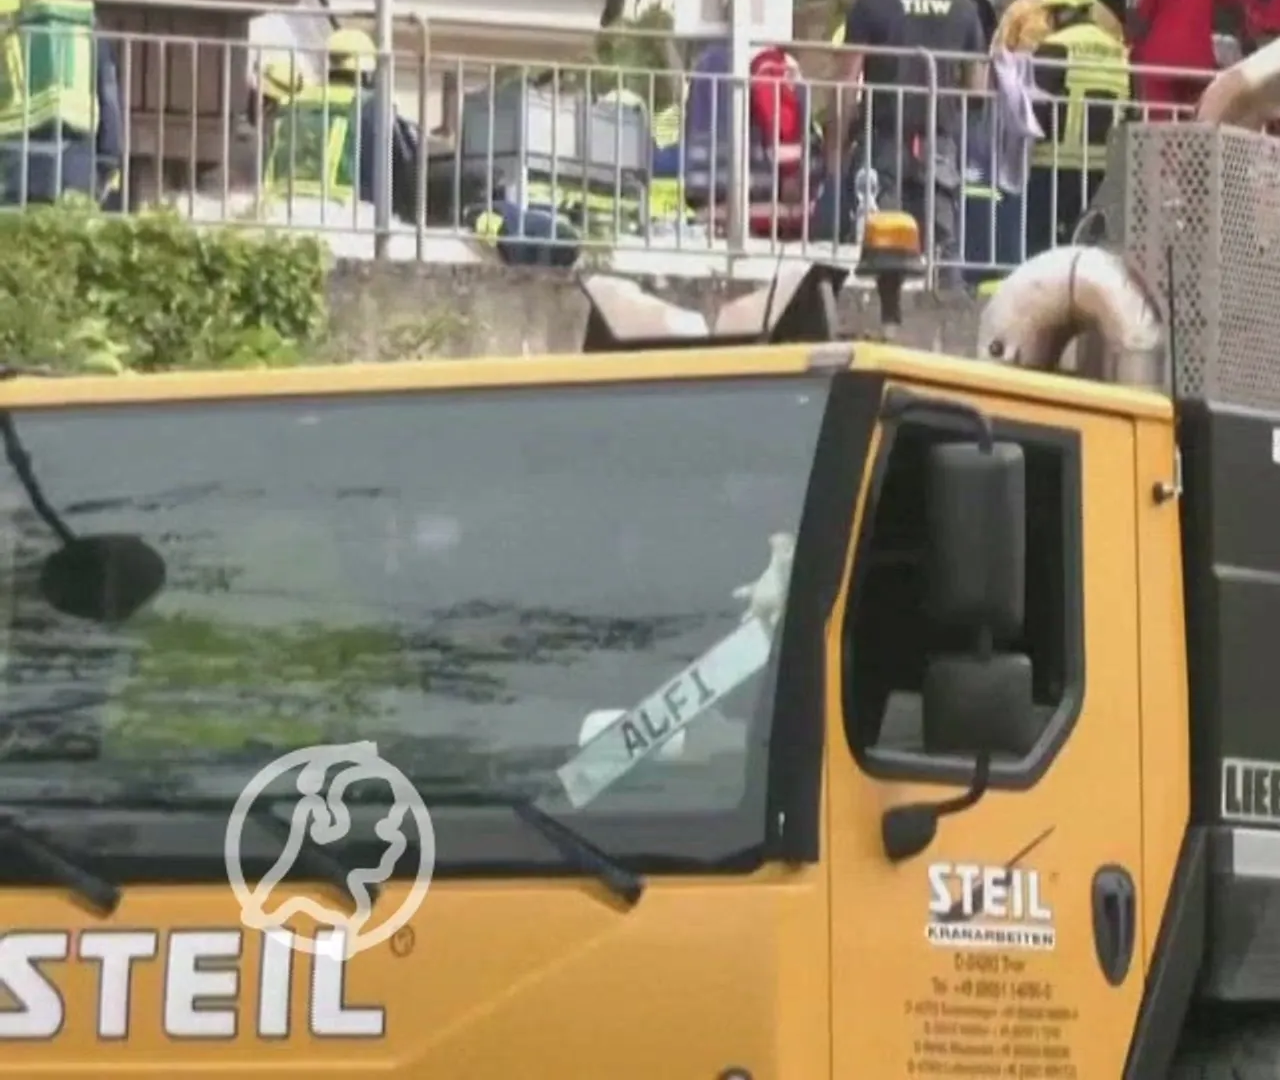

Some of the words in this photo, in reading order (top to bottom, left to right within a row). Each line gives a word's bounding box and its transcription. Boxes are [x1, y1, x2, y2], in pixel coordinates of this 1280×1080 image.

[620, 668, 716, 760] ALFI
[927, 862, 1052, 921] STEIL
[928, 925, 1054, 947] KRANARBEITEN
[0, 929, 385, 1039] STEIL
